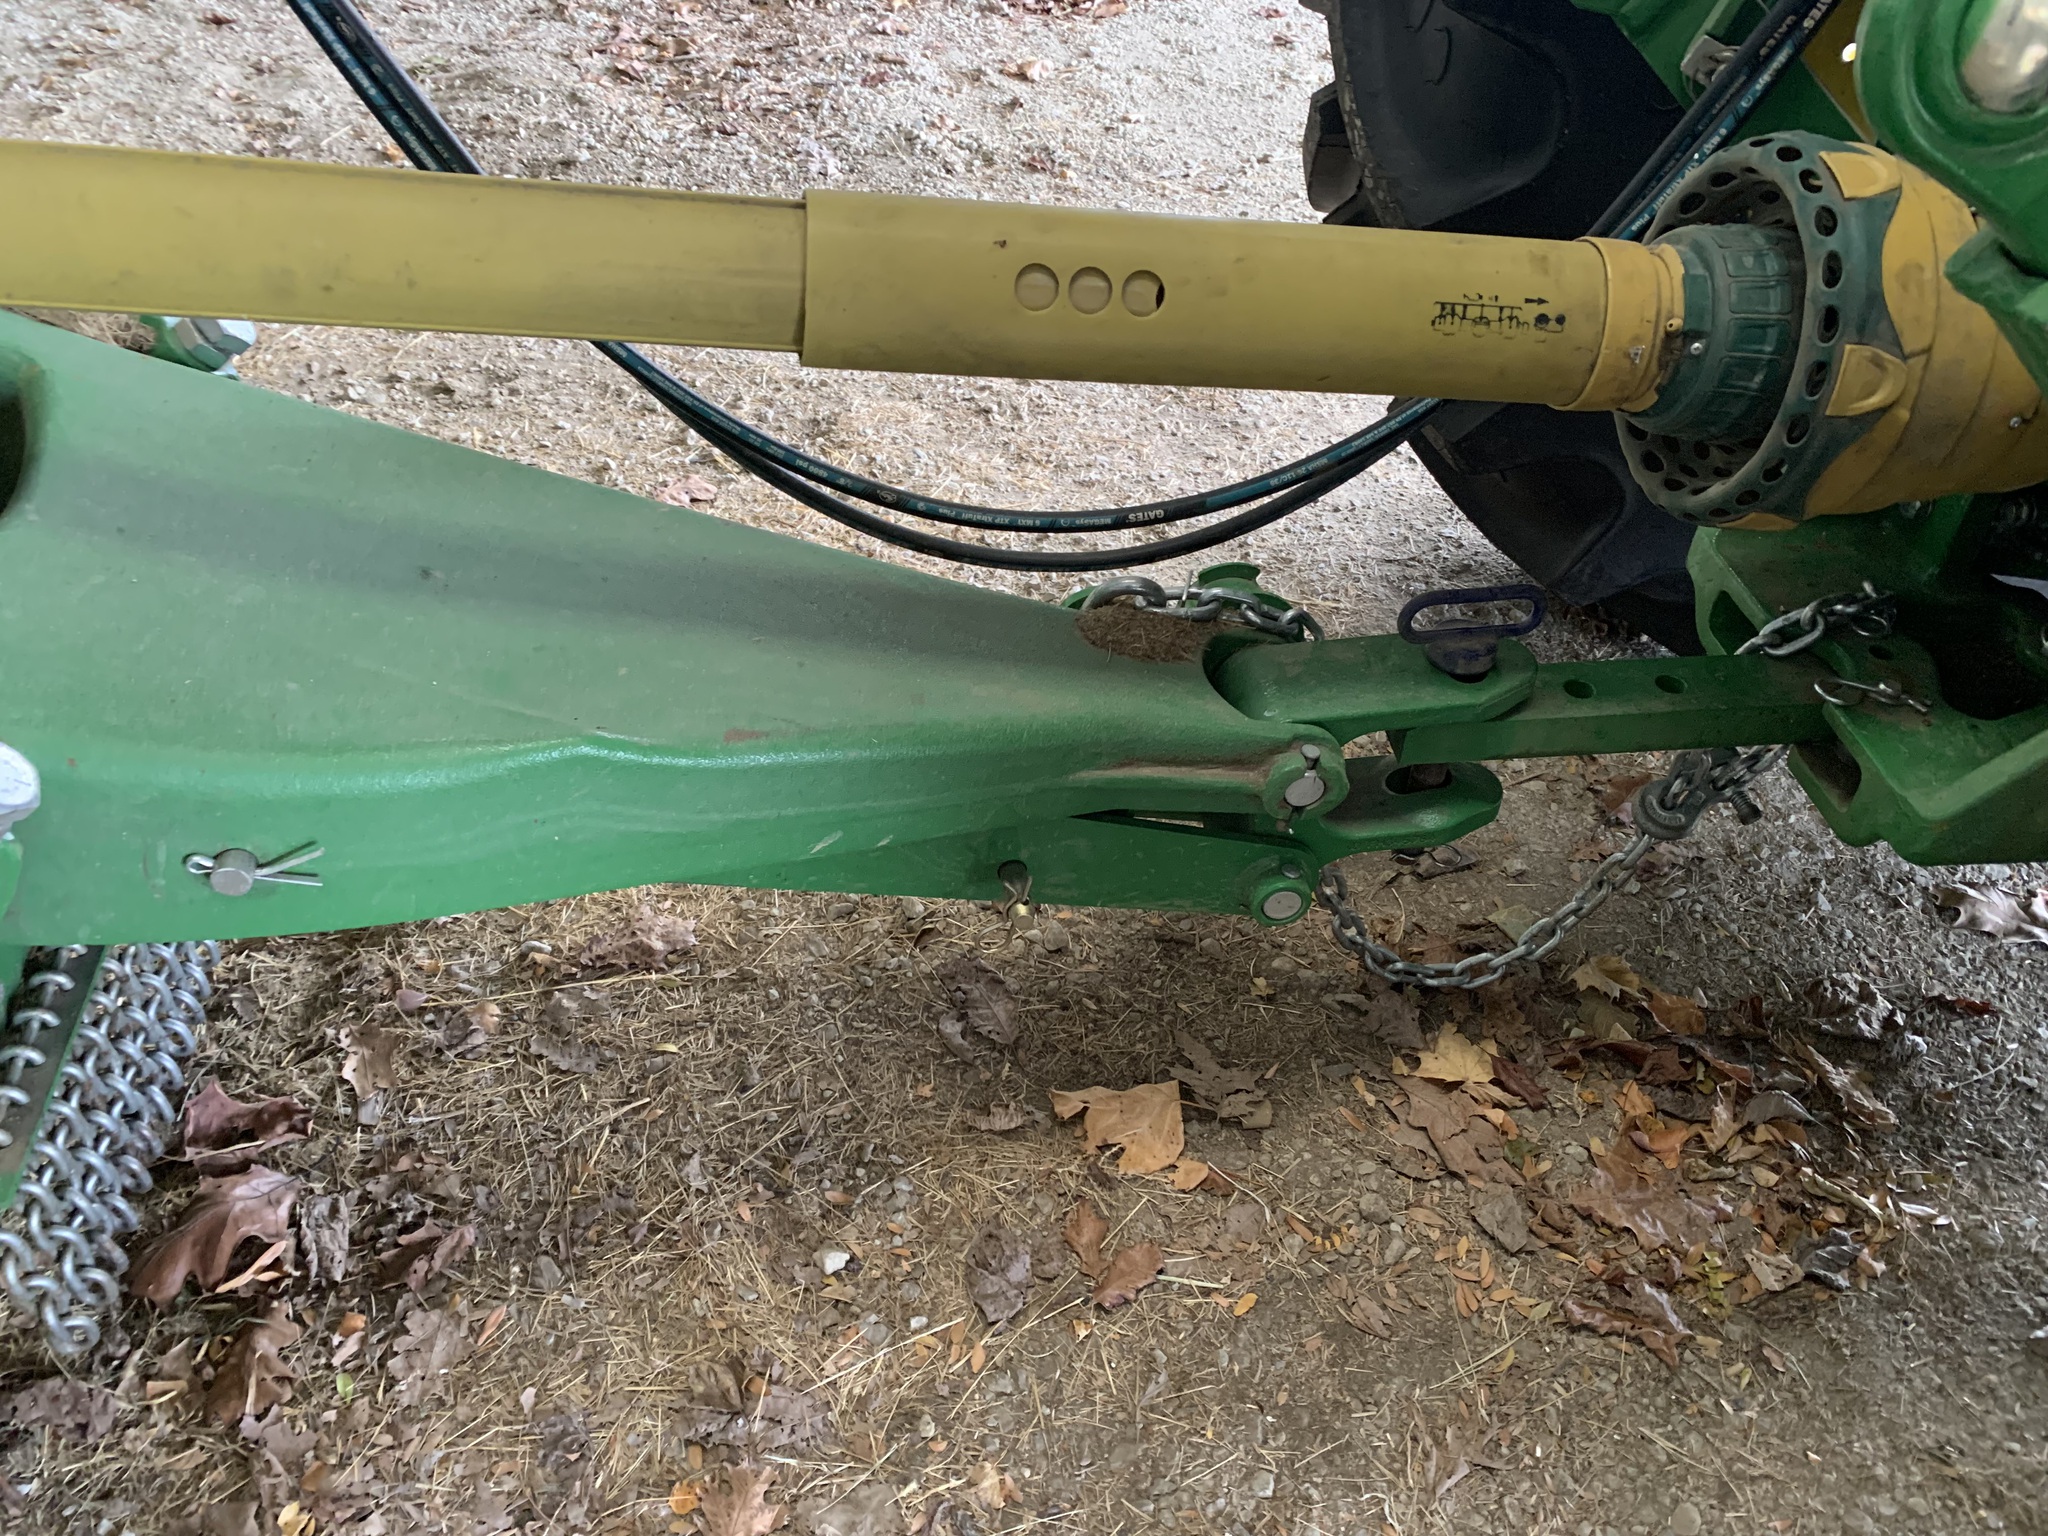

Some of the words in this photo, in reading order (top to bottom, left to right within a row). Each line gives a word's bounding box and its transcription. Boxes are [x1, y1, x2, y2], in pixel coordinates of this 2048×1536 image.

[1630, 212, 1650, 232] Plus
[793, 458, 809, 469] psi
[938, 507, 956, 516] Plus
[961, 511, 993, 522] XtraTuff
[1127, 508, 1165, 522] GATES
[1074, 517, 1111, 525] MEGASys
